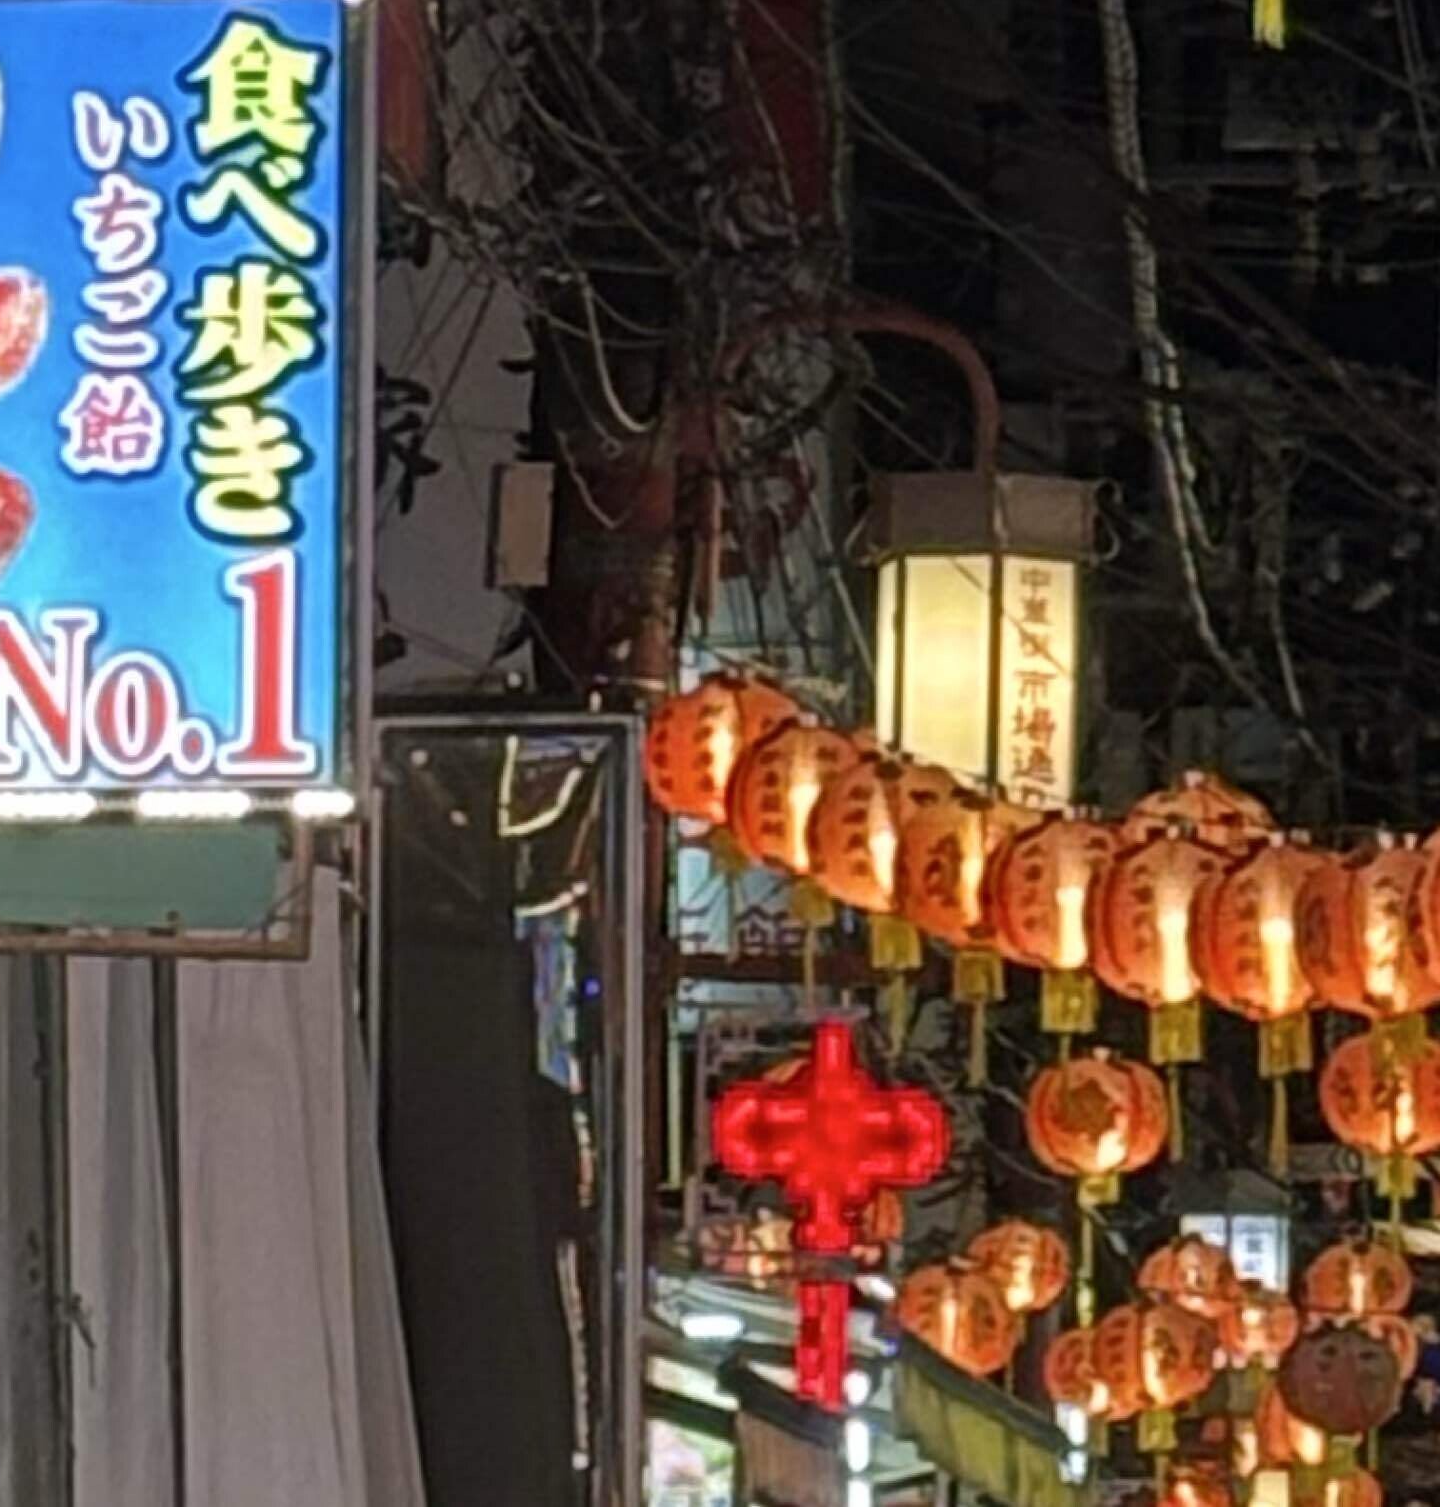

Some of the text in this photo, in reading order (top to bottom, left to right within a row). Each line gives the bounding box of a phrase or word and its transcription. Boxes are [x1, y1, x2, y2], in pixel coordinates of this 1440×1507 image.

[61, 90, 169, 479] いちご飴
[180, 16, 326, 541] 食べ歩き
